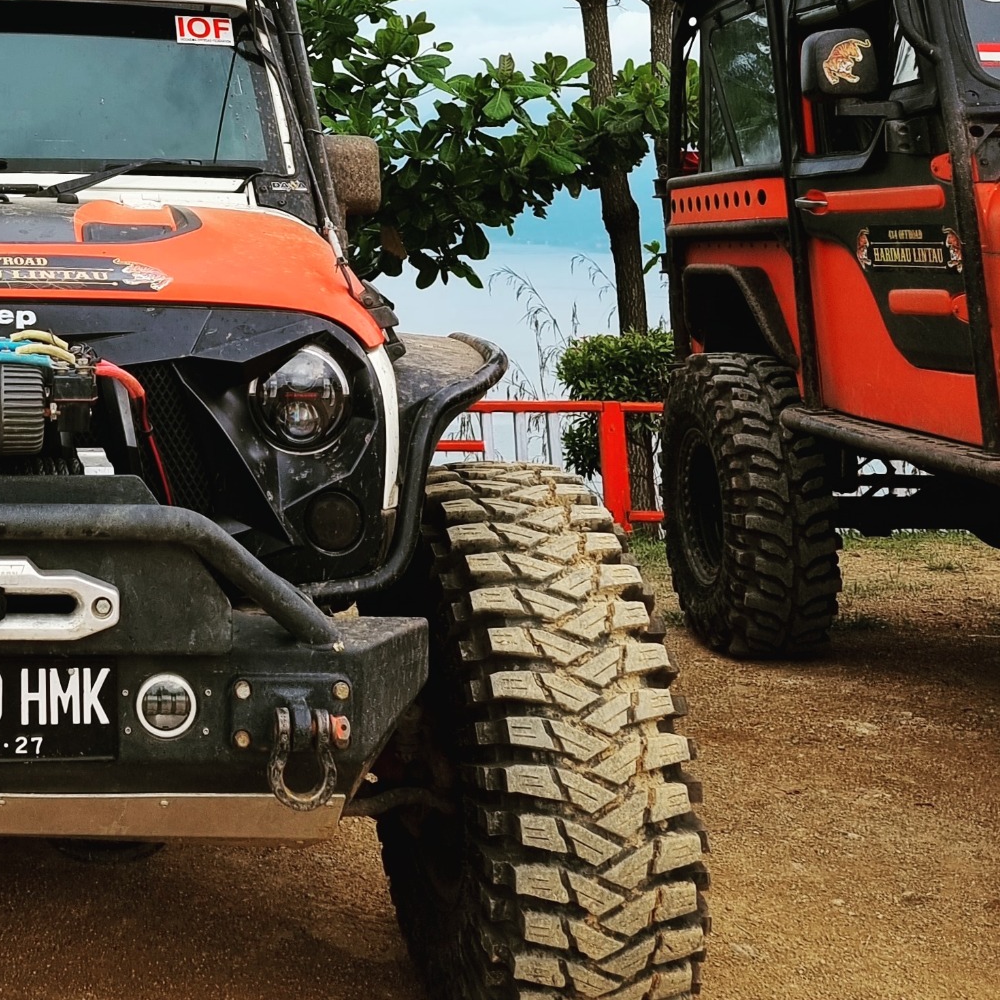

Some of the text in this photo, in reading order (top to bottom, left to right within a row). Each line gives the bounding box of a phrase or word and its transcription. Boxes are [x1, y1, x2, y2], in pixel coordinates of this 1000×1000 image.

[178, 17, 230, 38] IOF
[873, 247, 944, 263] HARIMAU LINTAU
[10, 269, 111, 281] LINTAU
[20, 667, 111, 726] HMK
